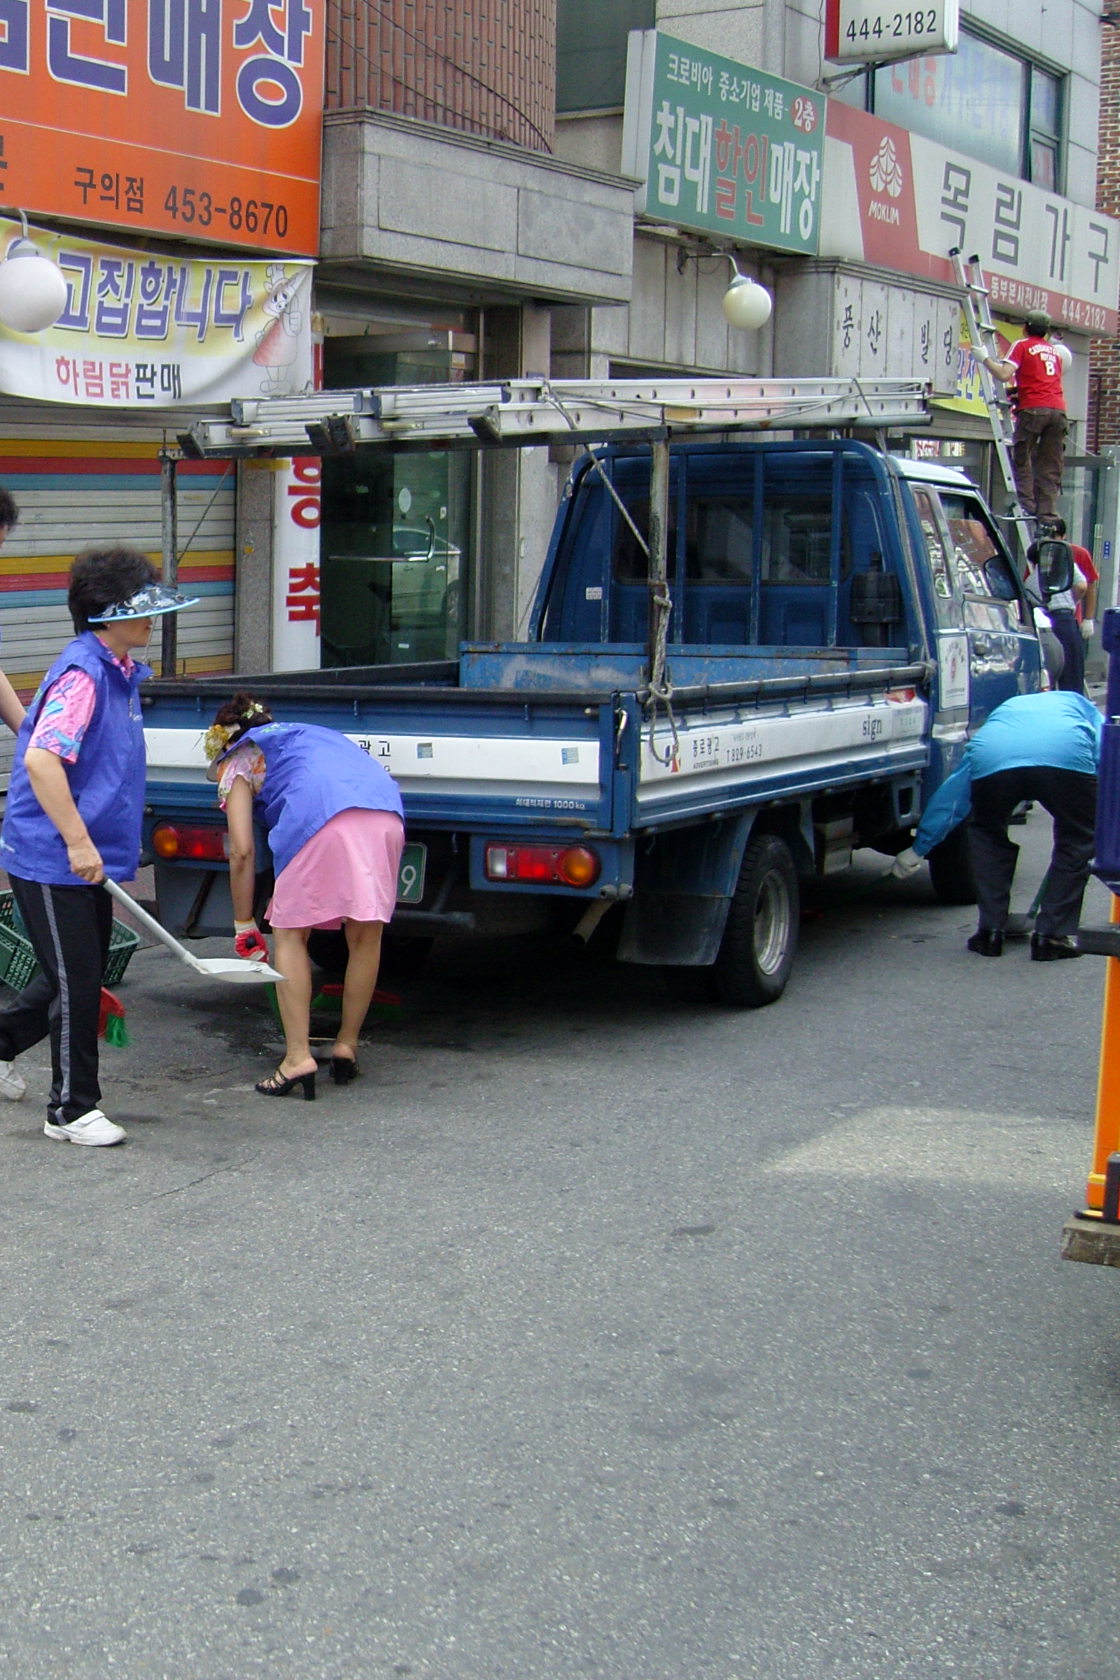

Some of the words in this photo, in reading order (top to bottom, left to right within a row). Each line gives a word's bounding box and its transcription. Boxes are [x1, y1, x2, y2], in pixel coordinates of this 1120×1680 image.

[846, 9, 936, 42] 444-2182
[667, 53, 713, 96] 크로비아
[718, 71, 761, 112] 중소기업
[794, 97, 815, 133] 2층
[74, 166, 144, 214] 구의점
[164, 185, 288, 238] 453-8670
[868, 199, 900, 227] MOKLIM
[1061, 298, 1106, 330] 444-2182
[863, 715, 882, 740] sign
[553, 800, 575, 809] 1000
[401, 865, 417, 896] 9
